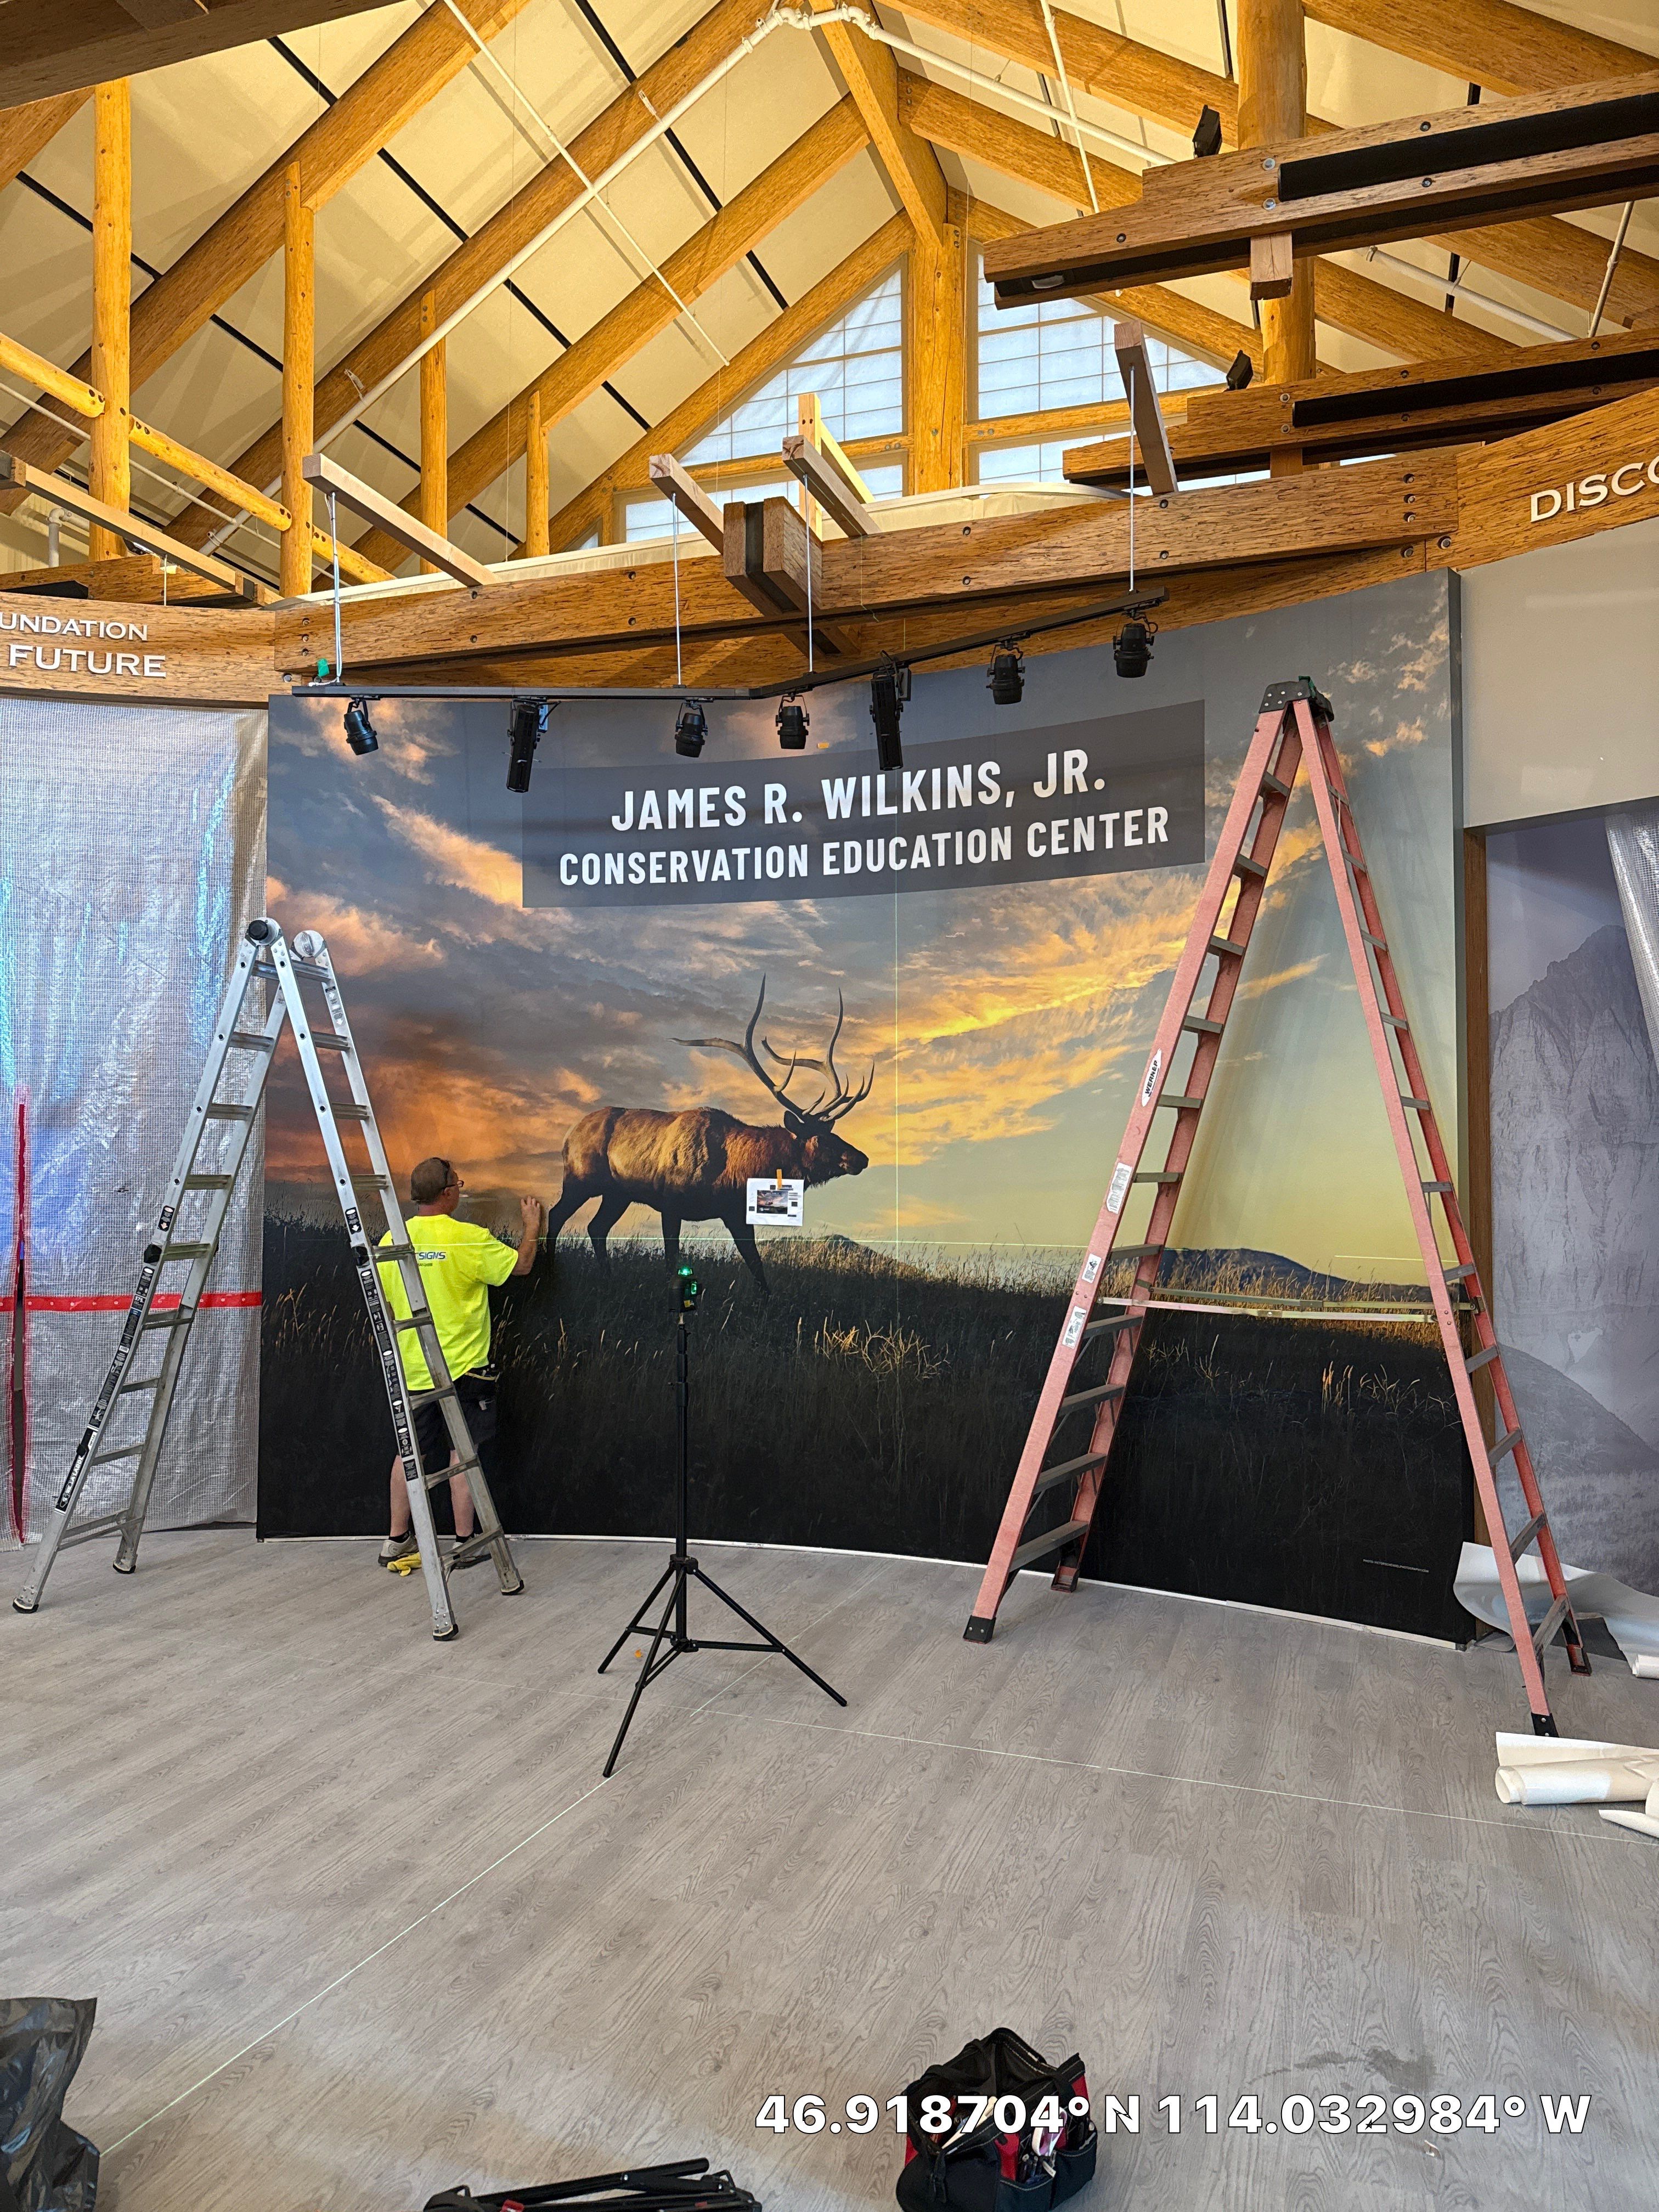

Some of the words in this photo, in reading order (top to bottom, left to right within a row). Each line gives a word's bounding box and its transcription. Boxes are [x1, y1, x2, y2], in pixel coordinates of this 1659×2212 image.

[0, 611, 148, 641] UNDATION
[8, 643, 167, 678] FUTURE
[611, 785, 747, 832] JAMES
[764, 782, 803, 825] R.
[820, 760, 1015, 820] WILKINS,
[1032, 748, 1105, 798] JR.
[560, 843, 808, 886] CONSERVATION
[822, 825, 1012, 876] EDUCATION
[1026, 806, 1169, 858] CENTER
[418, 1251, 446, 1260] SIGNS
